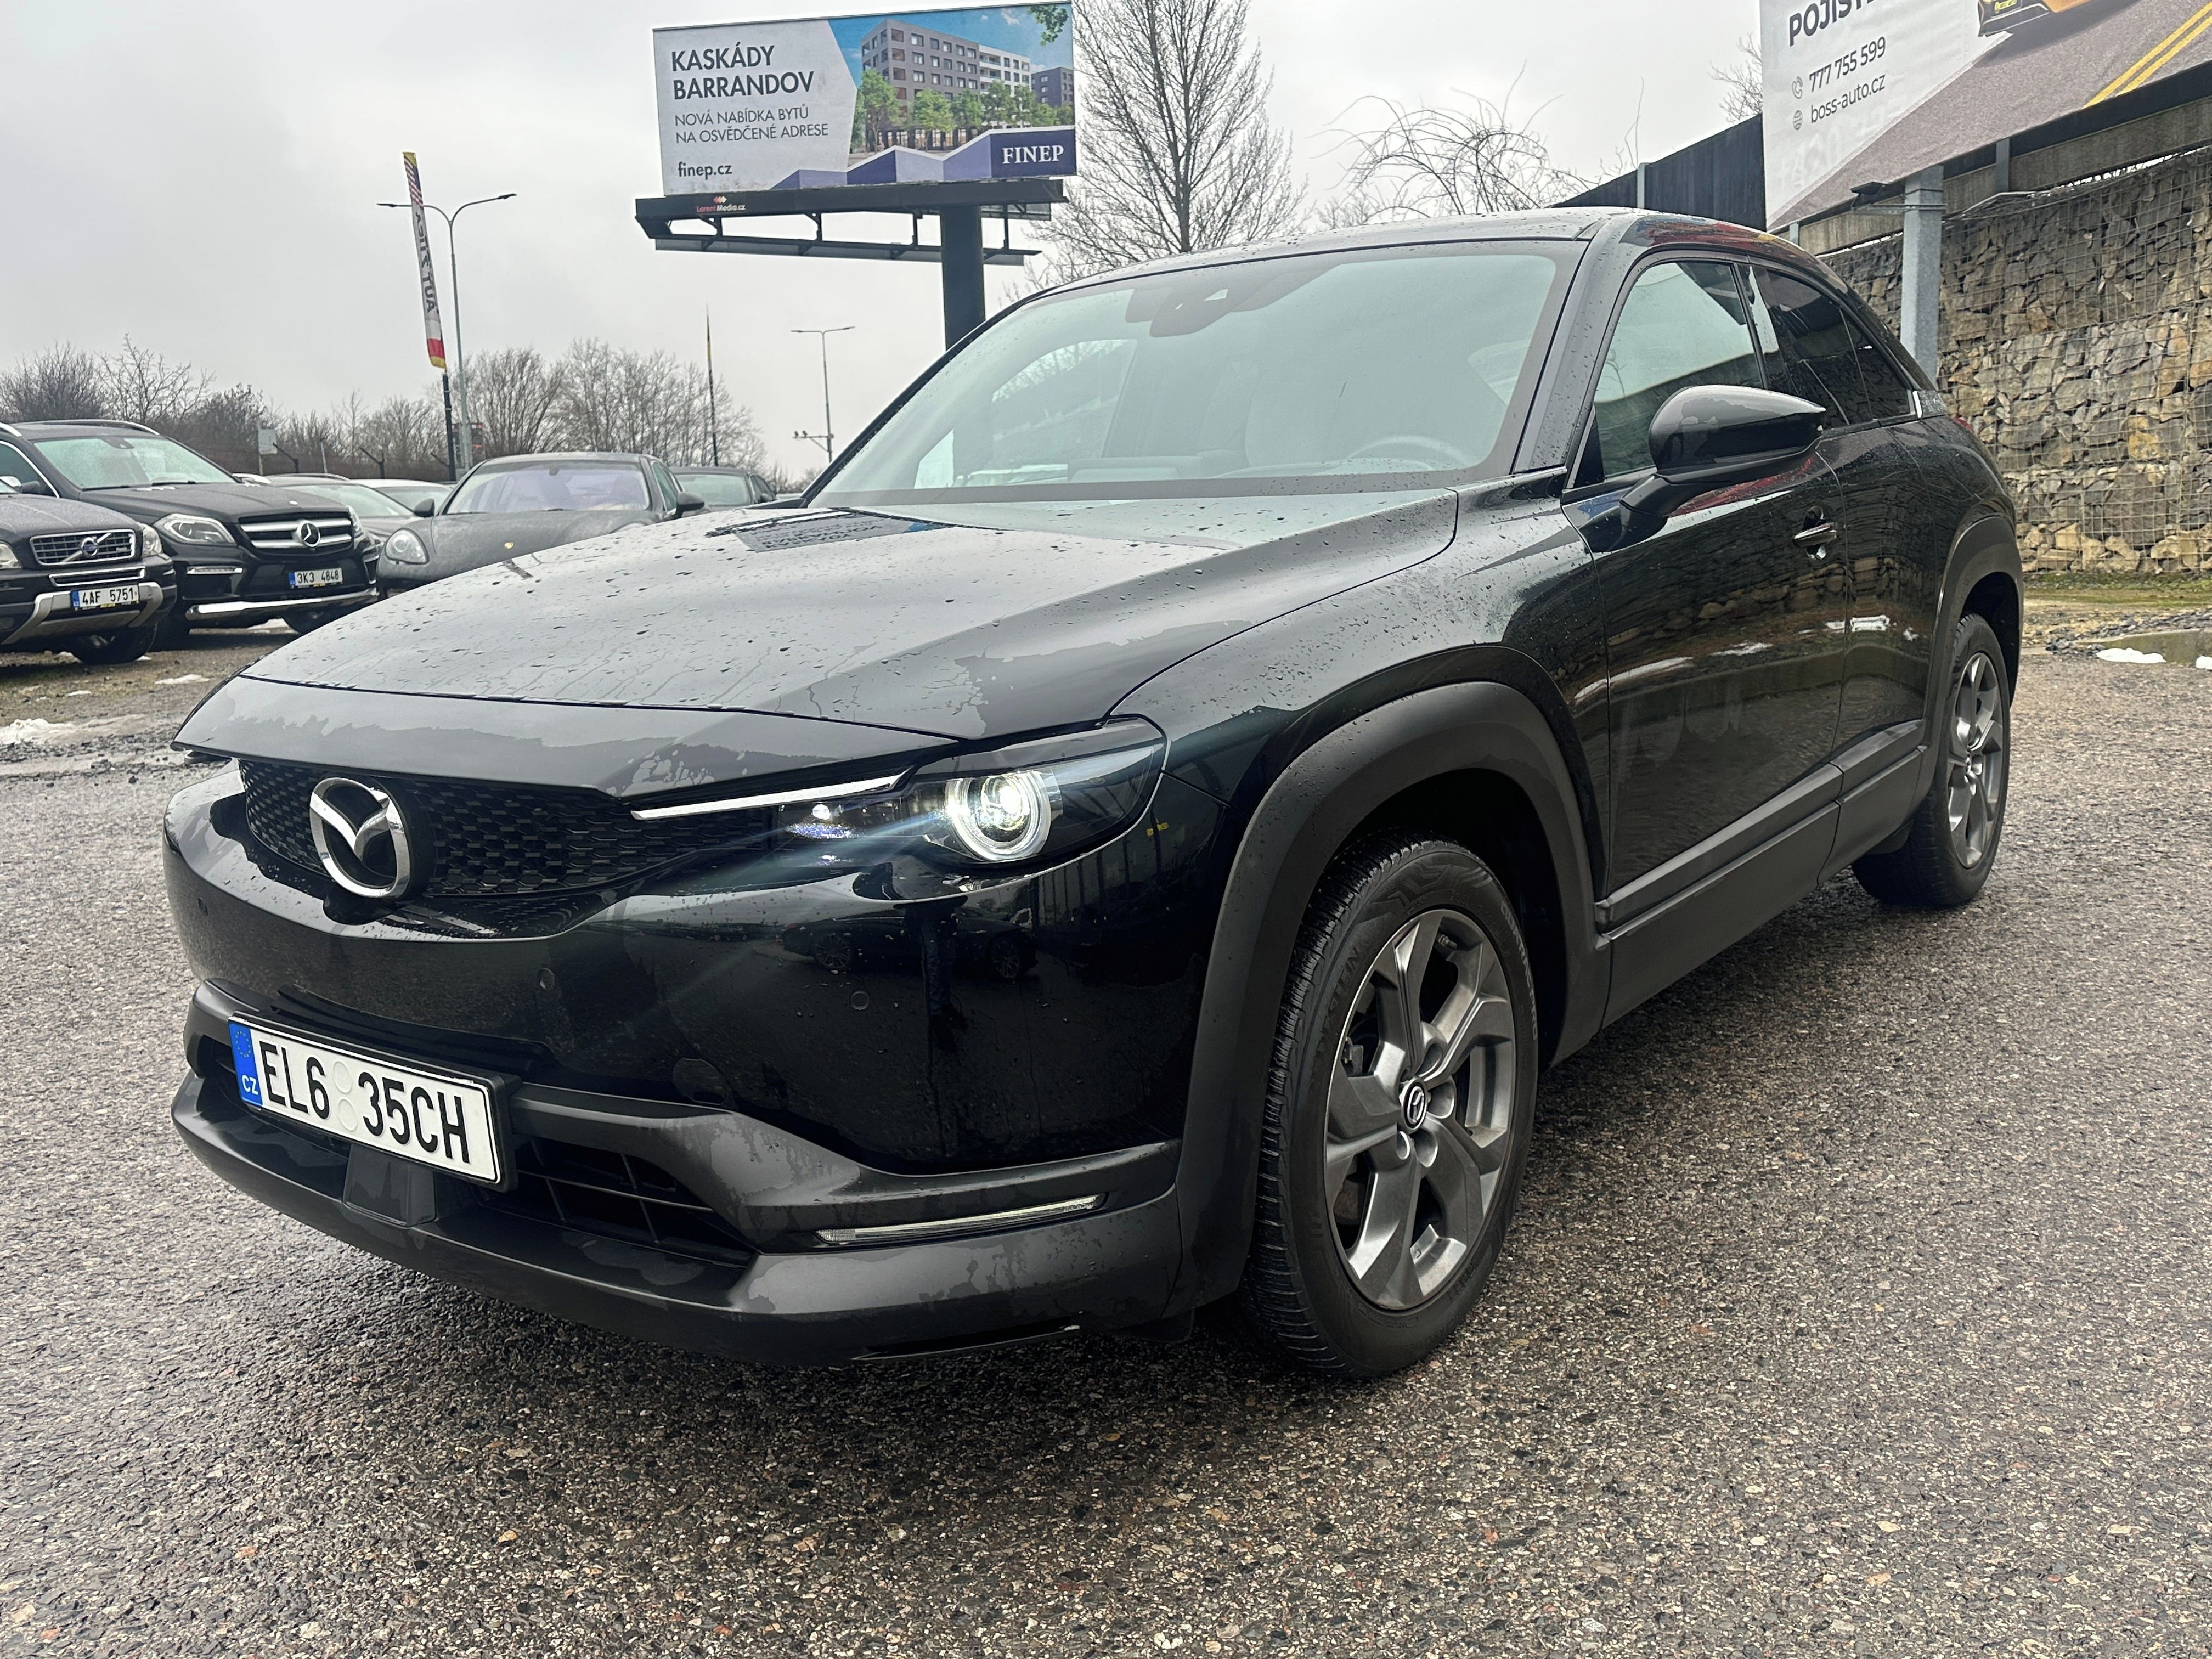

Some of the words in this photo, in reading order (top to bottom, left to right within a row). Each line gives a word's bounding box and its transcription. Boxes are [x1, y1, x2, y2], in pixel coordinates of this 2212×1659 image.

[1790, 0, 1874, 47] POJIS
[672, 41, 775, 71] KASKÁDY
[1809, 64, 1832, 92] 777
[1835, 50, 1857, 79] 755
[1860, 36, 1886, 66] 599
[673, 71, 814, 100] BARRANDOV
[1811, 74, 1886, 123] boss-auto.cz
[675, 109, 713, 126] NOVÁ
[717, 108, 775, 124] NABÍDKA
[778, 103, 809, 121] BYTŮ
[676, 131, 697, 144] NA
[699, 123, 777, 142] OSVĚDČENÉ
[781, 123, 828, 138] ADRESE
[1002, 145, 1064, 164] FINEP
[678, 161, 732, 180] finep.cz
[297, 572, 314, 584] 3K3
[321, 569, 339, 582] 4848
[83, 590, 101, 605] 4AF
[110, 587, 134, 601] 5751
[241, 1074, 259, 1096] CZ
[259, 1040, 330, 1120] EL6
[358, 1071, 471, 1164] 35CH
